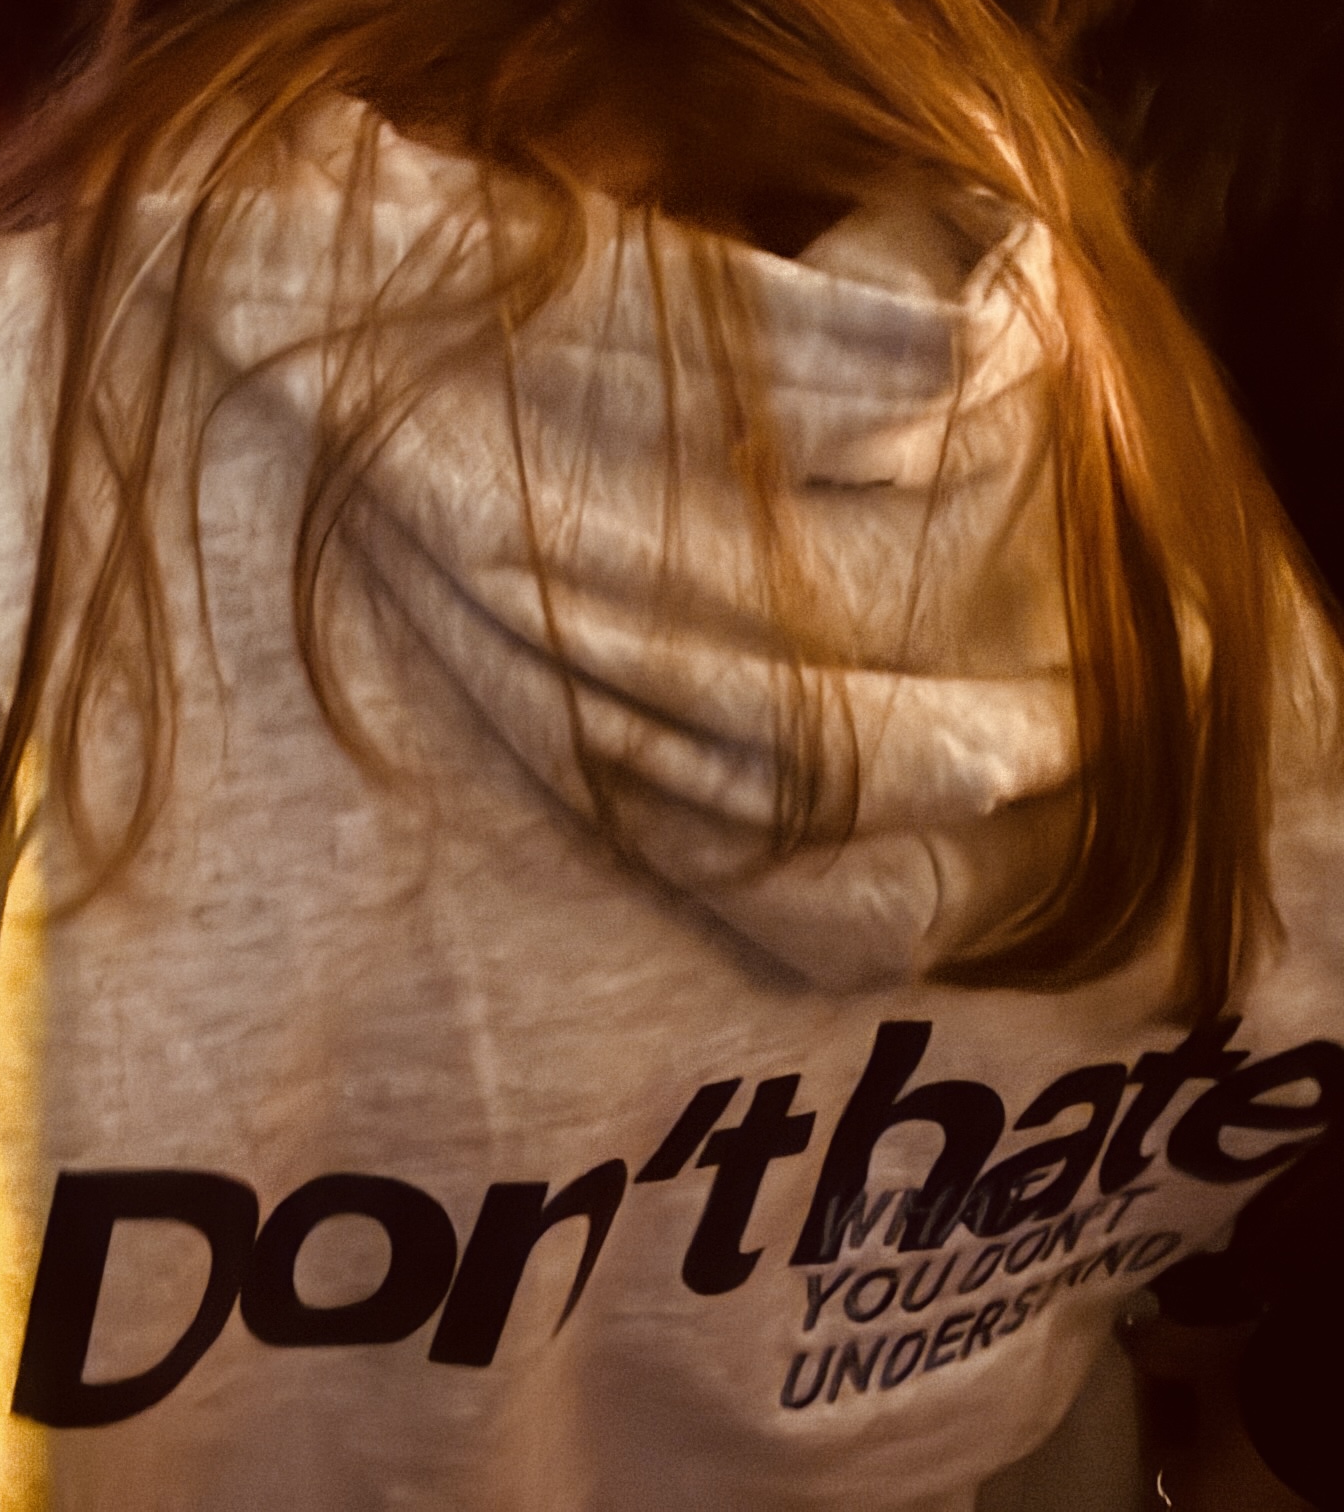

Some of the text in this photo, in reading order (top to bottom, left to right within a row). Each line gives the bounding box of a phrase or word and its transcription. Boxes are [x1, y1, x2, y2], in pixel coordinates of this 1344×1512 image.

[10, 1015, 1344, 1429] Don't hate
[803, 1253, 958, 1331] YOU
